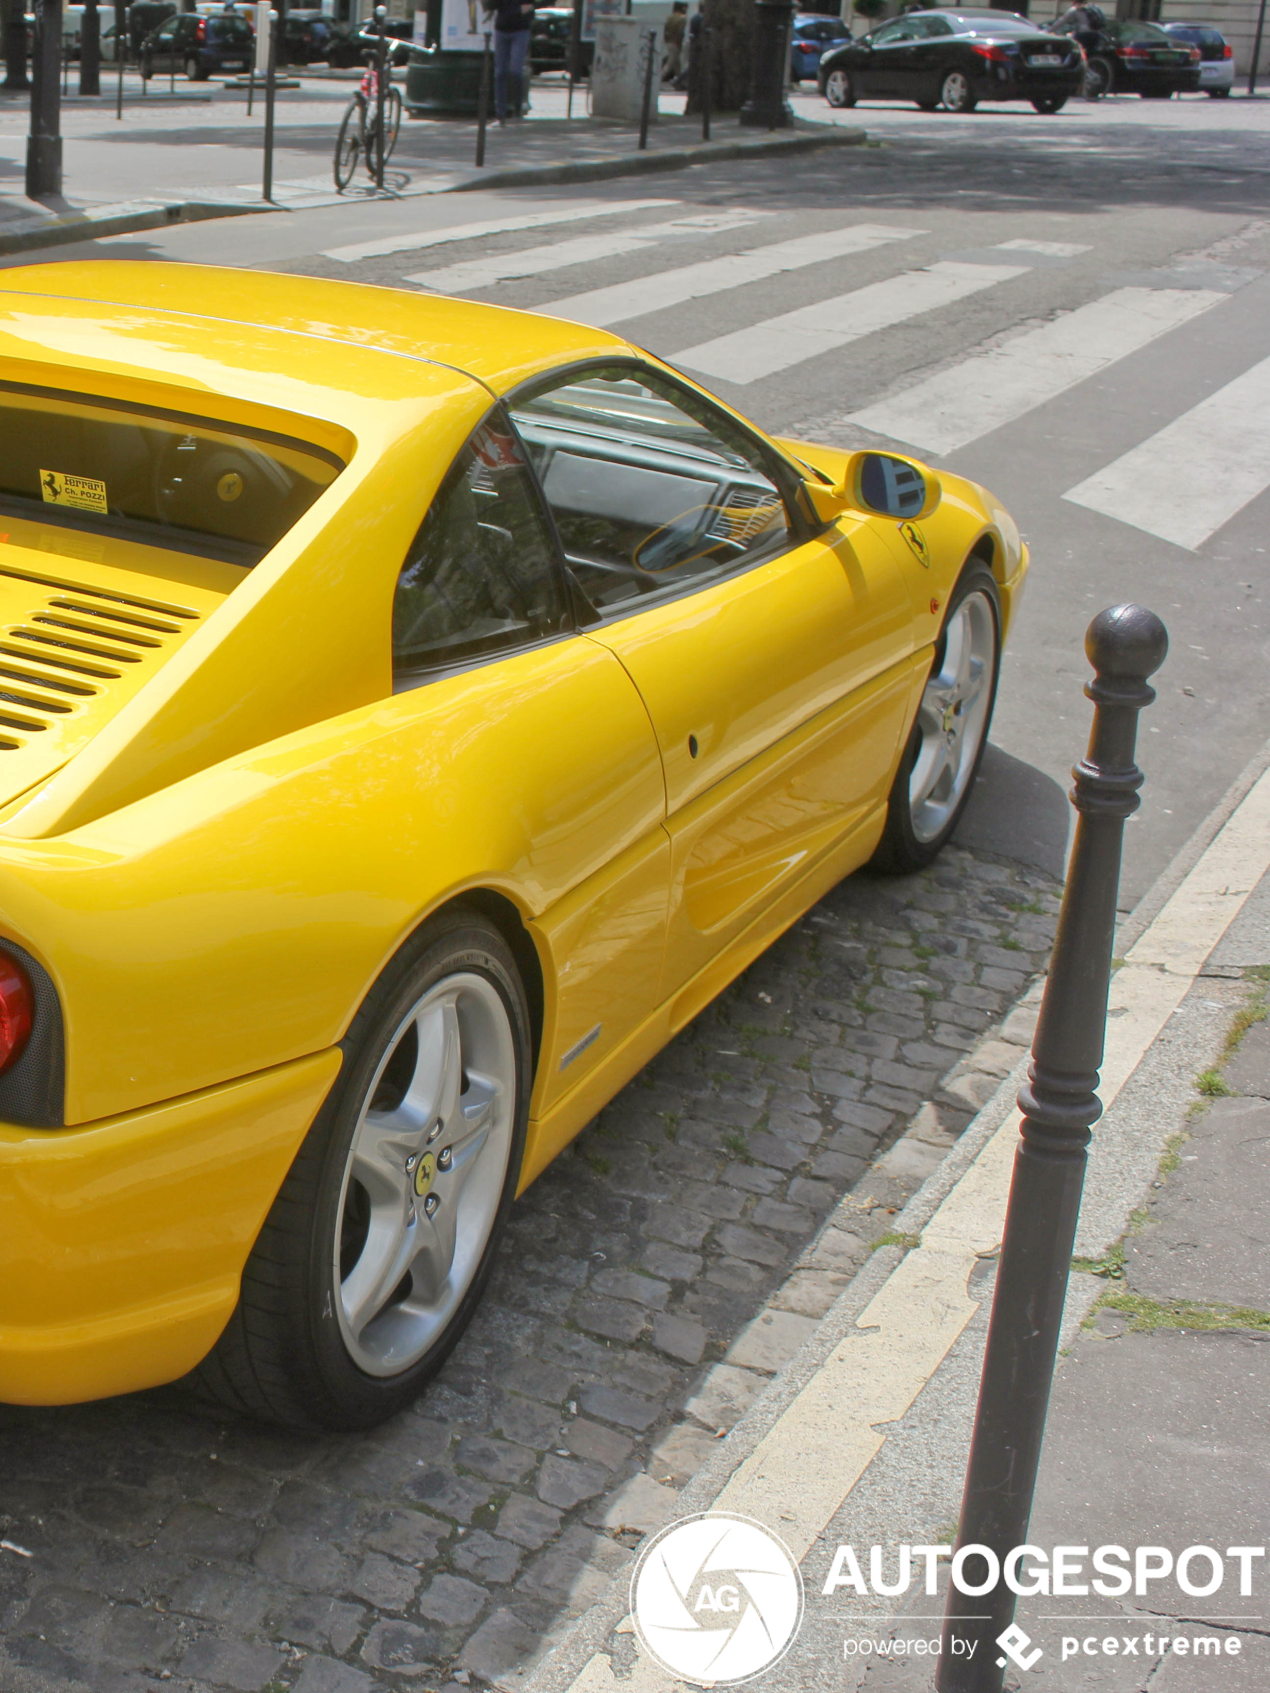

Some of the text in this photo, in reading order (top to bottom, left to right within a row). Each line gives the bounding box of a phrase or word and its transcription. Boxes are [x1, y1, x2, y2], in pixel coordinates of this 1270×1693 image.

[64, 475, 104, 492] Ferrari
[65, 487, 78, 496] Ch.
[80, 490, 106, 501] POZZI
